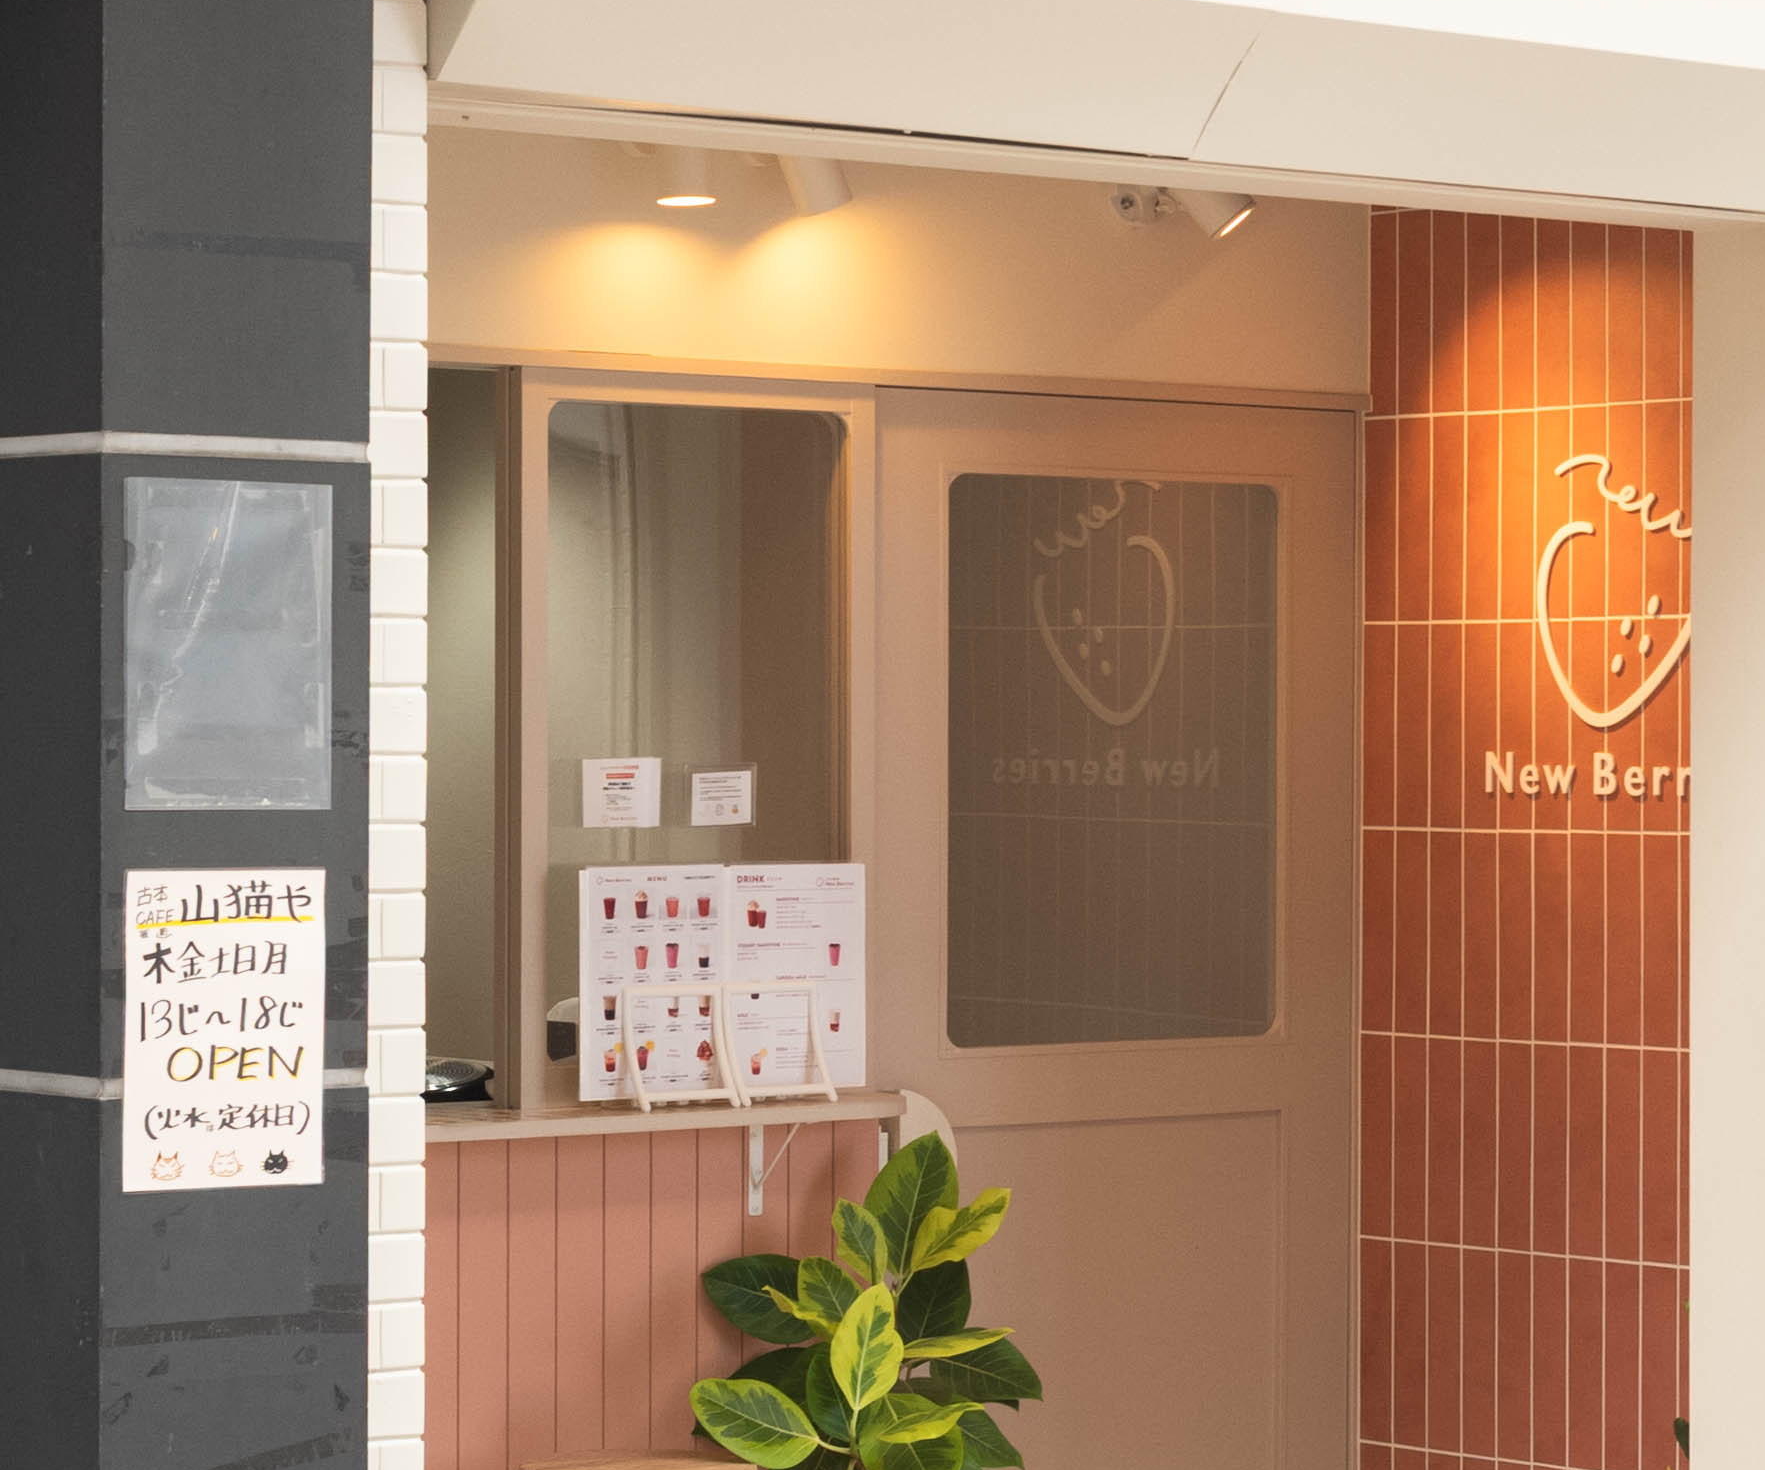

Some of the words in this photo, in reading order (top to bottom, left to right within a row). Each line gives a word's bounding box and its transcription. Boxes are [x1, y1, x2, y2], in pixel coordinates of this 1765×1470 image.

[1485, 751, 1576, 795] New
[736, 874, 765, 884] DRINK
[136, 909, 174, 925] CAFE
[180, 880, 312, 922] 山猫や
[143, 941, 288, 984] 木金土日月
[167, 1044, 305, 1082] OPEN
